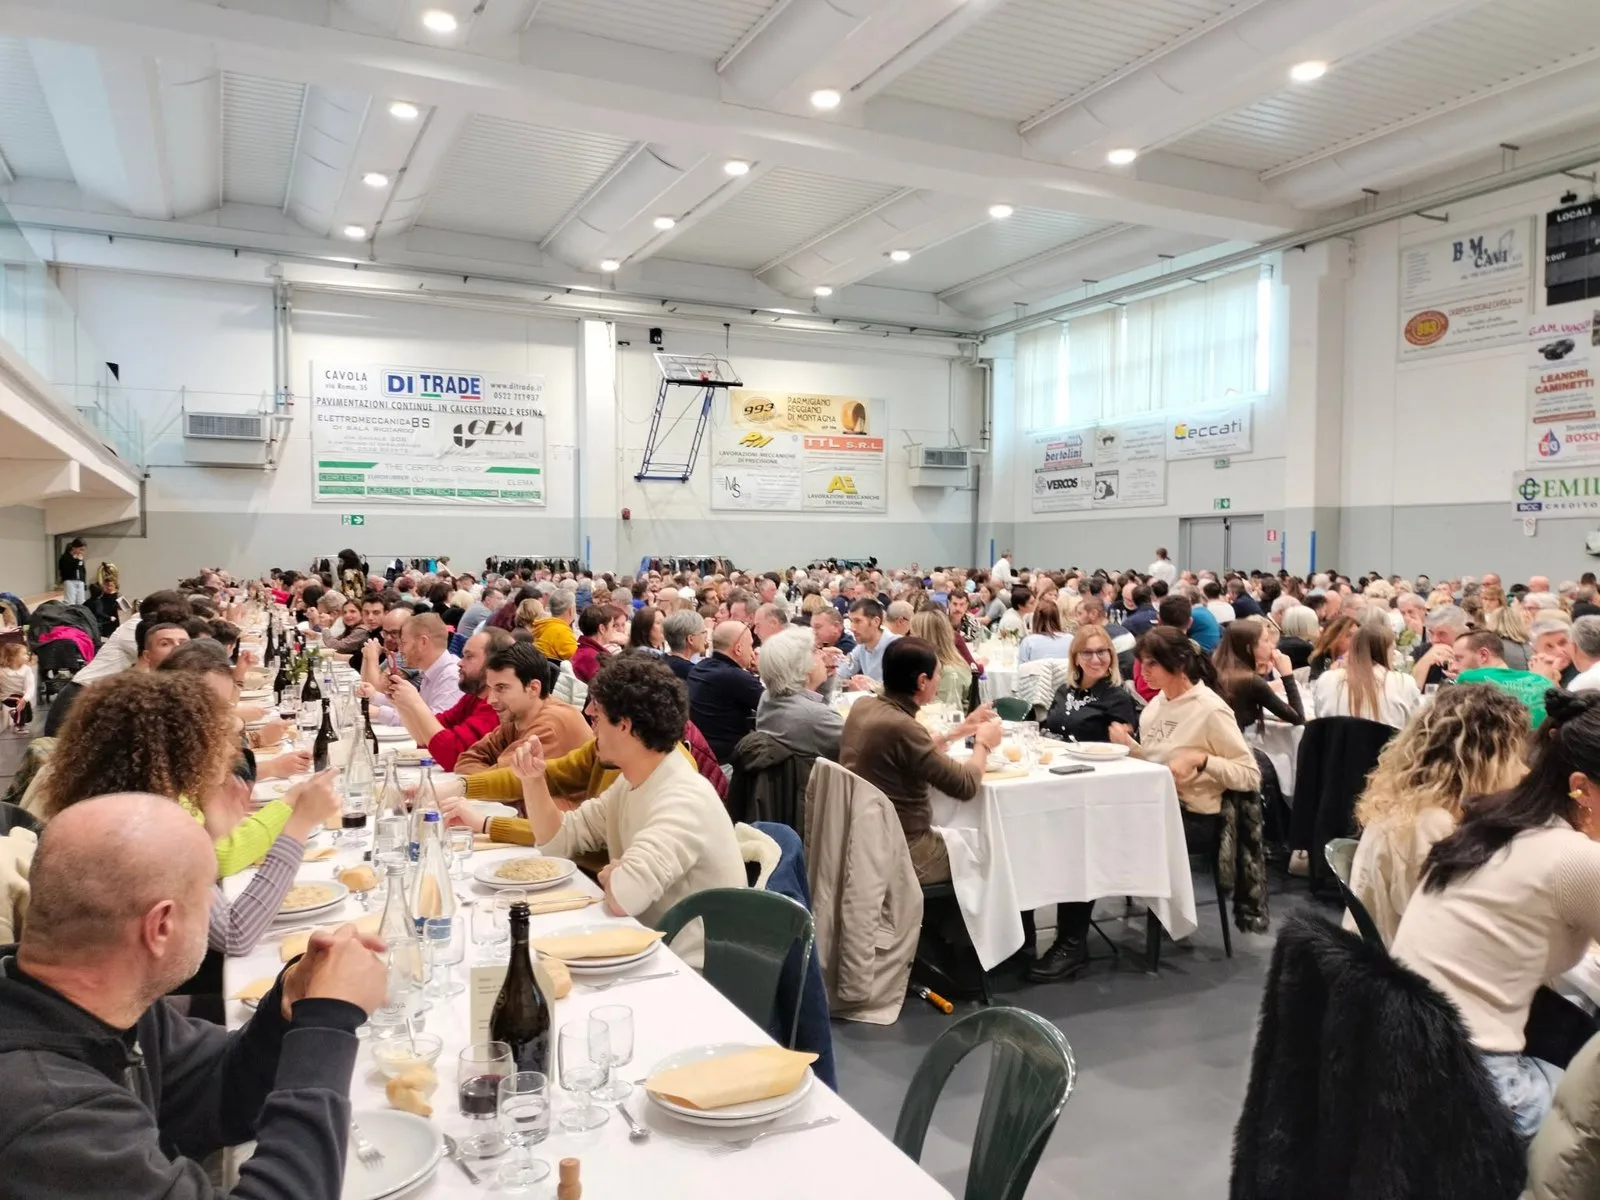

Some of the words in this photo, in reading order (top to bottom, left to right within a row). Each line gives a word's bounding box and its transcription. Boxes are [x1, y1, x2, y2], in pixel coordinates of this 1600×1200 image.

[1556, 206, 1592, 222] LOCALI
[325, 370, 368, 381] CAVOLA
[1541, 369, 1589, 383] LEANDRI
[387, 374, 414, 394] DI
[420, 374, 481, 395] TRADE
[1535, 378, 1594, 394] CAMINETTI
[316, 397, 388, 409] PAVIMENTAZIONI
[390, 401, 433, 411] CONTINUE
[438, 403, 447, 412] IN
[450, 404, 508, 415] CALCESTRUZZO
[516, 408, 543, 417] RESINA
[787, 396, 831, 406] PARMIGIANO
[743, 402, 775, 416] 993
[787, 405, 822, 414] REGGIANO
[317, 414, 411, 426] ELETTROMECCANICA
[787, 413, 795, 421] DI
[797, 413, 837, 422] MONTAGNA
[467, 419, 523, 436] GEM
[804, 438, 840, 448] TTL
[1045, 447, 1082, 462] bertolini
[1046, 477, 1079, 490] VERCOS
[1545, 502, 1598, 510] CREDITO
